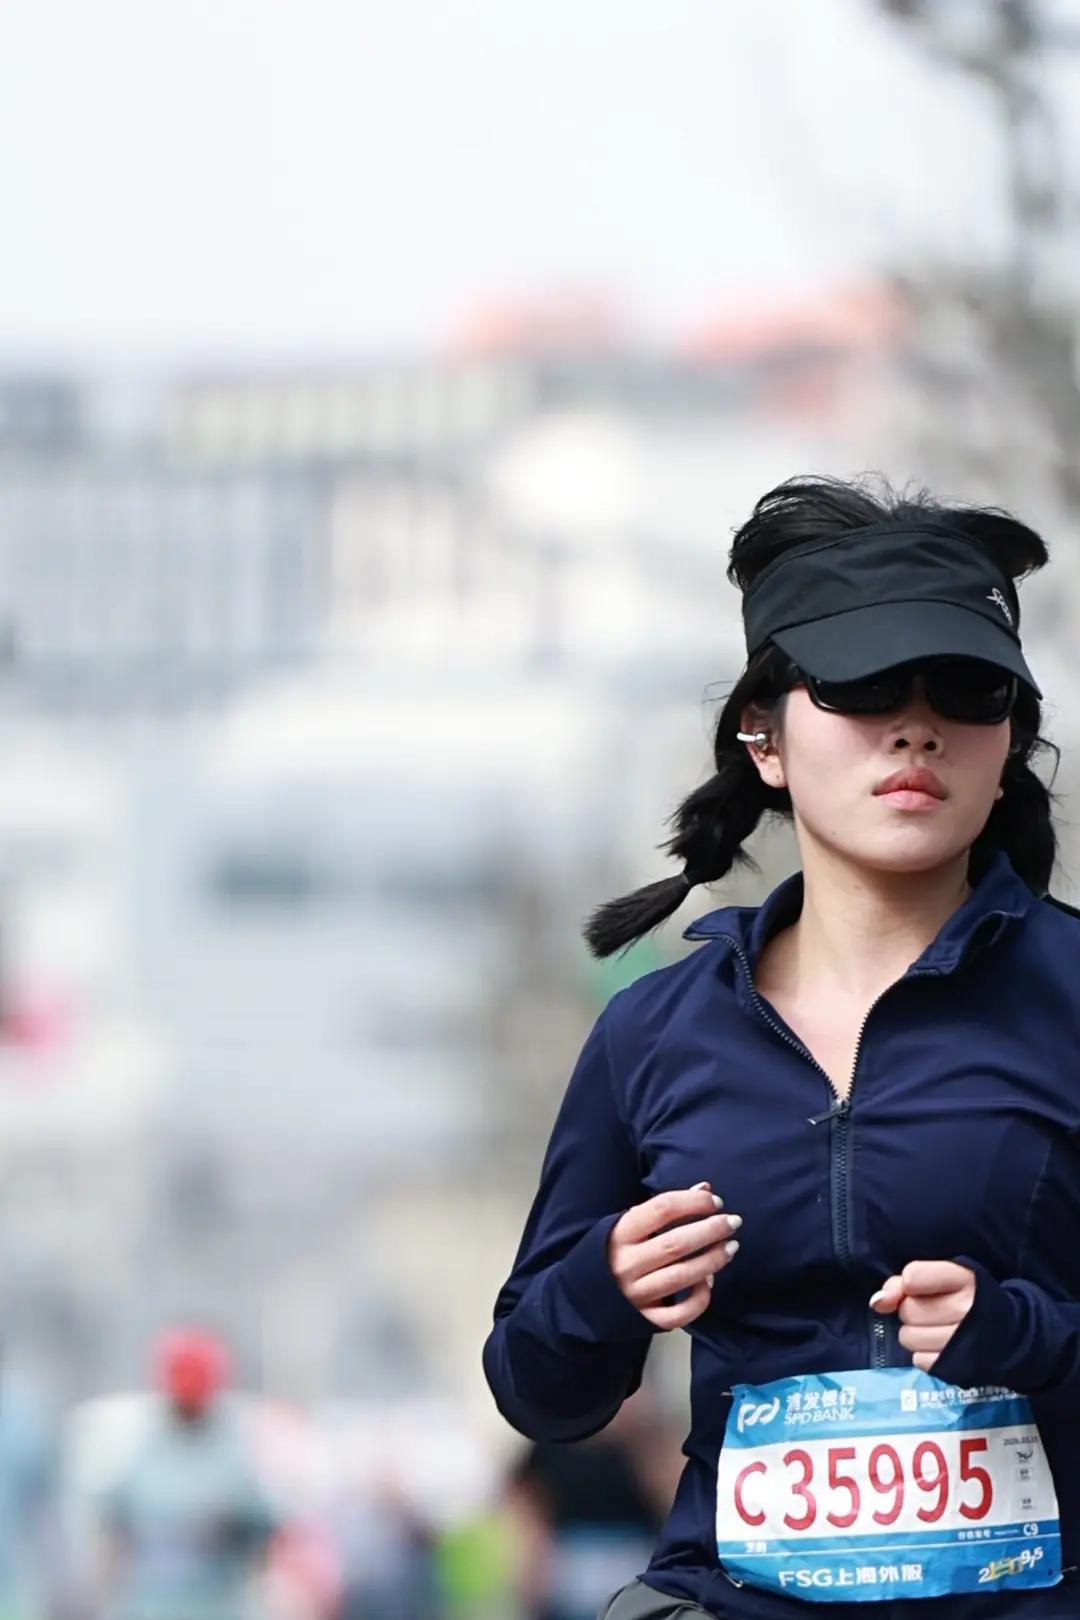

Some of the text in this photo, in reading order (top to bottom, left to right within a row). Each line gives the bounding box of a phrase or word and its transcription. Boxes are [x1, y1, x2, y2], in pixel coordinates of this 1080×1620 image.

[786, 1387, 857, 1411] 浦发银行
[734, 1437, 993, 1531] C35995
[1023, 1522, 1039, 1537] C9
